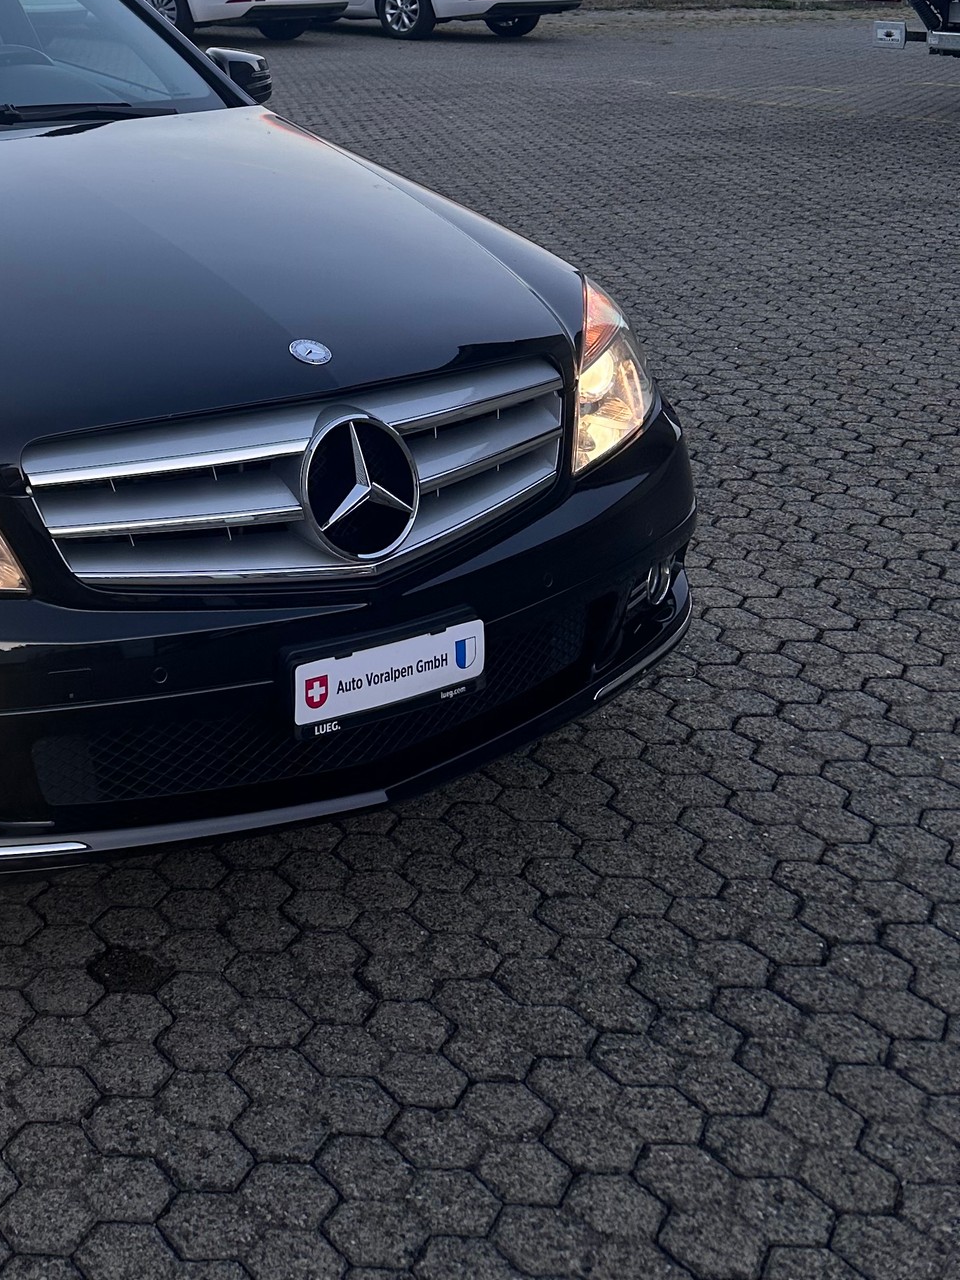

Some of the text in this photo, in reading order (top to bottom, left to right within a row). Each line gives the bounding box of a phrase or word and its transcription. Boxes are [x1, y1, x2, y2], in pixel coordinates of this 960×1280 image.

[336, 652, 449, 695] Auto Voralpen GmbH
[440, 686, 466, 699] lueg.com
[314, 720, 342, 736] LUEG.
